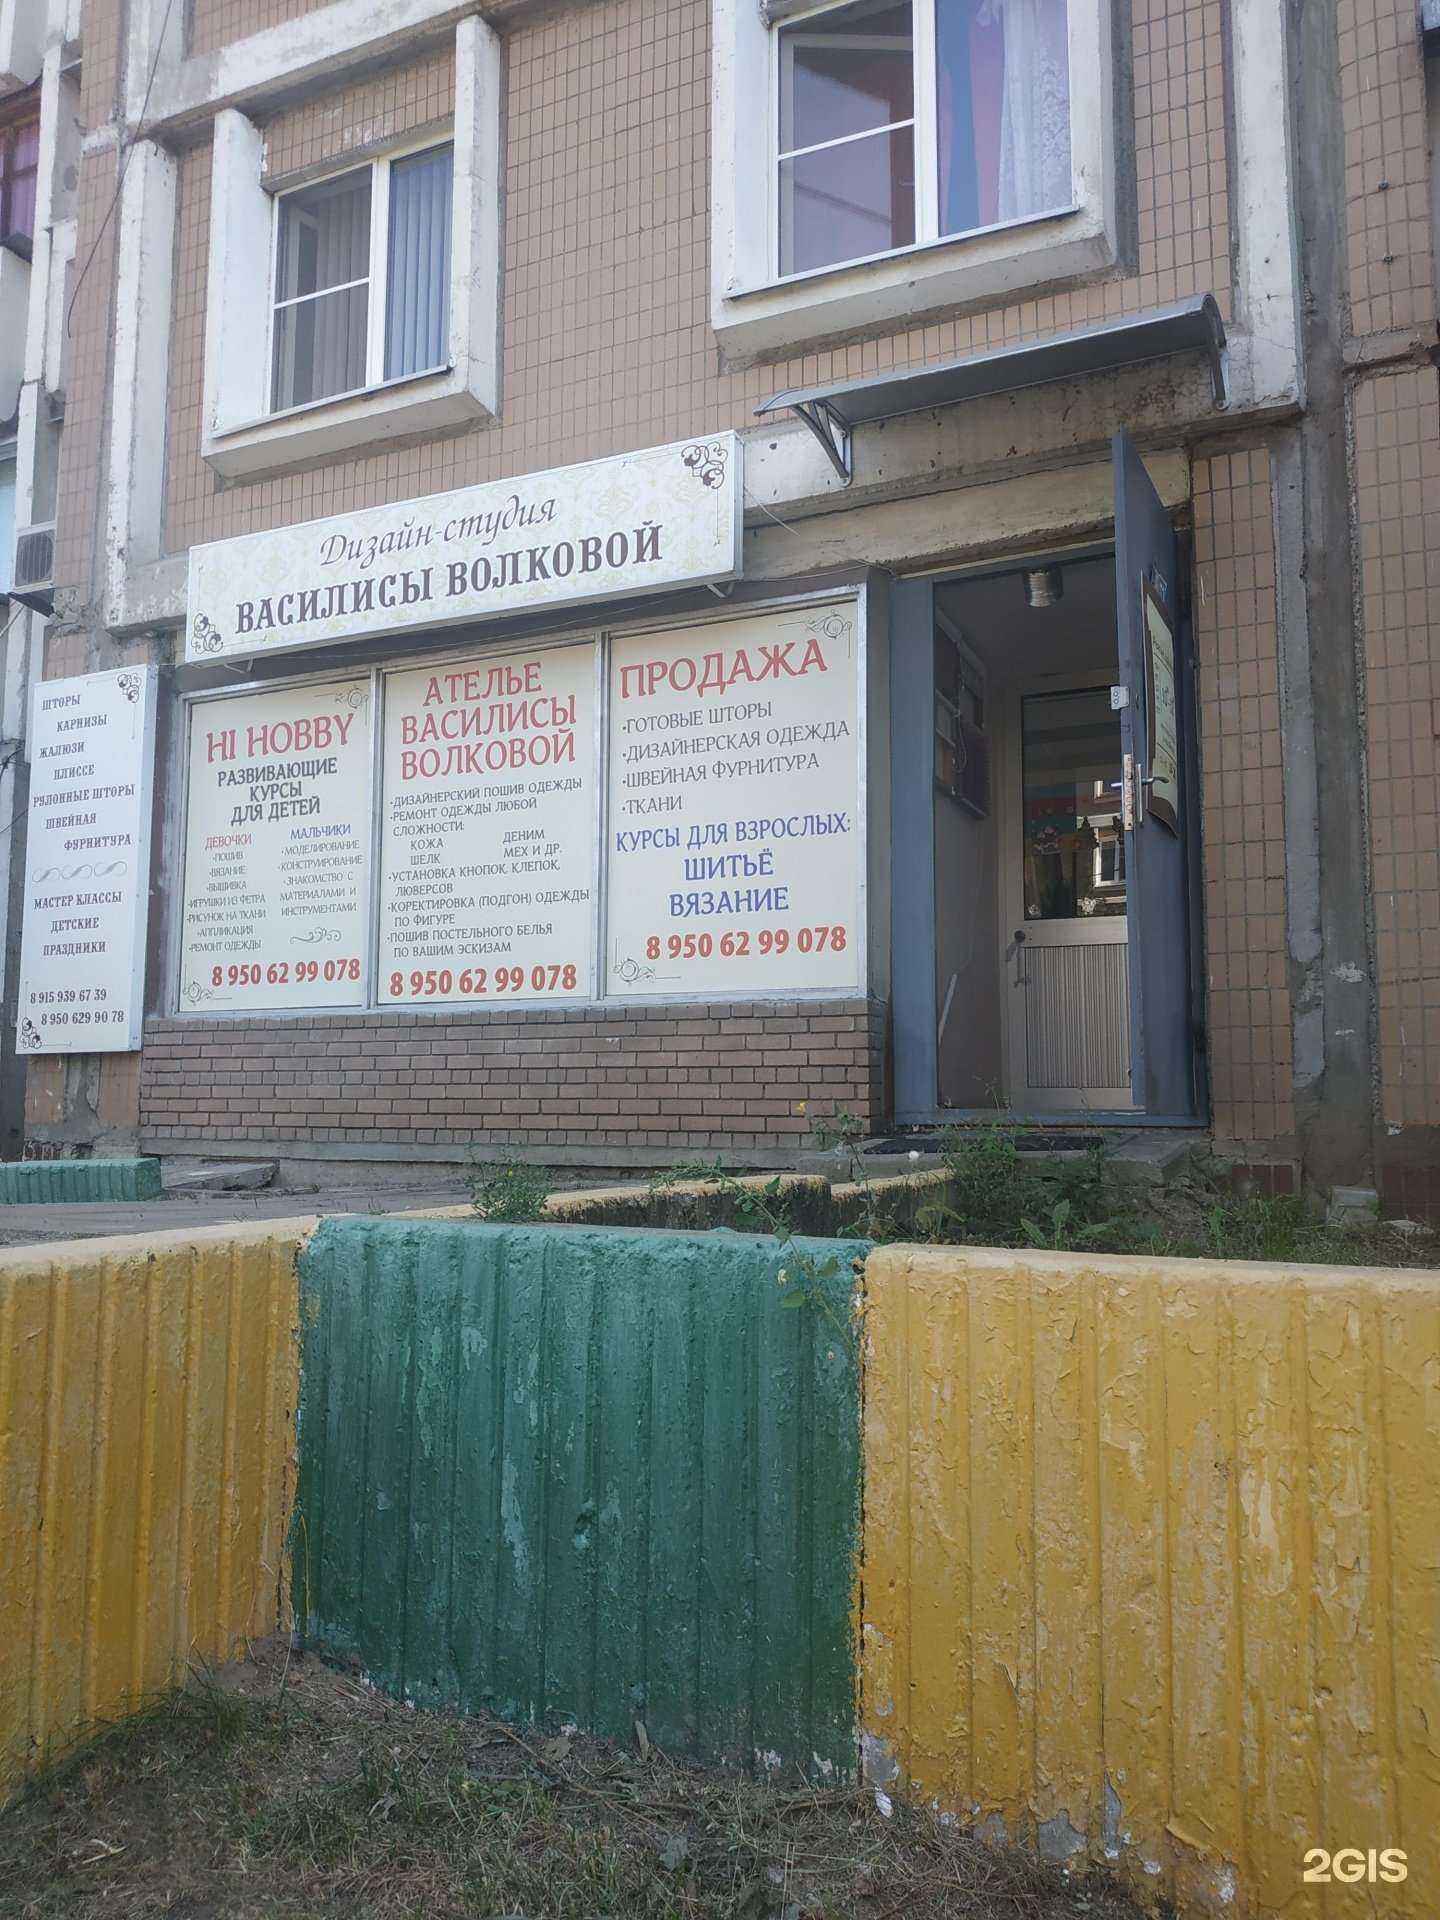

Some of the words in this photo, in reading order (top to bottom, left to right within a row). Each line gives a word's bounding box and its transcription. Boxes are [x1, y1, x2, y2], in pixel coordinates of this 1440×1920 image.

[319, 493, 558, 569] Дизайн-студия
[235, 567, 434, 635] ВАСИЛИСЫ
[445, 520, 663, 598] ВОЛКОВОЙ
[620, 638, 828, 699] ПРОДАЖА
[423, 661, 542, 706] АТЕЛЬЕ
[42, 695, 81, 710] ШТОРЫ
[56, 714, 108, 732] КАРНИЗЫ
[401, 695, 576, 745] ВАСИЛИСЫ
[627, 710, 703, 734] ГОТОВЫЕ
[709, 701, 772, 724] ШТОРЫ
[207, 729, 236, 763] HI
[247, 713, 354, 757] HOBBY
[627, 731, 760, 764] ДИЗАЙНЕРСКАЯ
[766, 720, 850, 746] ОДЕЖДА
[39, 742, 85, 758] ЖАЛЮЗИ
[401, 728, 576, 780] ВОЛКОВОЙ
[53, 764, 95, 780] ПЛИССЕ
[218, 757, 338, 787] РАЗВИВАЮЩИЕ
[627, 765, 706, 787] ШВЕЙНАЯ
[712, 753, 819, 779] ФУРНИТУРА
[33, 790, 90, 808] РУЛОННЫЕ
[92, 784, 135, 799] ШТОРЫ
[250, 781, 302, 802] КУРСЫ
[393, 786, 480, 809] ДИЗАЙНЕРСКИЙ
[484, 783, 524, 799] ПОШИВ
[528, 778, 582, 795] ОДЕЖДЫ
[231, 803, 263, 826] ДЛЯ
[268, 796, 320, 822] ДЕТЕЙ
[393, 808, 437, 822] РЕМОНТ
[441, 802, 492, 818] ОДЕЖДЫ
[495, 797, 537, 813] ЛЮБОЙ
[627, 795, 682, 815] ТКАНИ
[46, 813, 97, 829] ШВЕЙНАЯ
[393, 821, 464, 837] СЛОЖНОСТИ:
[205, 834, 252, 850] ДЕВОЧКИ
[290, 824, 351, 840] МАЛЬЧИКИ
[503, 829, 545, 844] ДЕНИМ
[616, 827, 680, 852] КУРСЫ
[686, 823, 728, 850] ДЛЯ
[735, 812, 851, 843] ВЗРОСЛЫХ:
[64, 834, 131, 851] ФУРНИТУРА
[410, 838, 444, 851] КОЖА
[503, 846, 528, 859] МЕХ
[532, 845, 541, 855] И
[544, 843, 562, 856] ДР.
[410, 853, 441, 866] ШЕЛК
[684, 849, 774, 881] ШИТЬЁ
[392, 866, 456, 882] УСТАНОВКА
[34, 895, 74, 909] МАСТЕР
[76, 891, 122, 905] КЛАССЫ
[395, 883, 453, 897] ЛЮВЕРСОВ
[282, 902, 357, 917] ИНСТРУМЕНТАМИ
[391, 898, 475, 913] КОРЕКТИРОВКА
[478, 893, 532, 908] (ПОДГОН)
[535, 889, 590, 905] ОДЕЖДЫ
[670, 887, 789, 917] ВЯЗАНИЕ
[50, 917, 100, 933] ДЕТСКИЕ
[394, 917, 410, 927] ПО
[413, 914, 455, 926] ФИГУРЕ
[391, 930, 429, 943] ПОШИВ
[432, 925, 513, 941] ПОСТЕЛЬНОГО
[517, 923, 553, 936] БЕЛЬЯ
[646, 936, 660, 960] 8
[668, 933, 712, 959] 950
[720, 931, 749, 957] 62
[759, 930, 789, 955] 99
[797, 926, 846, 953] 078
[42, 941, 106, 956] ПРАЗДНИКИ
[394, 947, 409, 958] ПО
[413, 944, 454, 956] ВАШИМ
[457, 941, 511, 955] ЭСКИЗАМ
[212, 966, 223, 986] 8
[228, 964, 262, 986] 950
[267, 962, 288, 984] 62
[295, 960, 318, 983] 99
[324, 958, 360, 981] 078
[390, 971, 403, 996] 8
[411, 969, 452, 996] 950
[459, 968, 487, 994] 62
[495, 966, 524, 993] 99
[531, 964, 577, 991] 078
[30, 992, 36, 1004] 8
[38, 992, 54, 1003] 915
[57, 990, 76, 1002] 939
[79, 989, 91, 1001] 67
[94, 989, 107, 1001] 39
[41, 1013, 47, 1025] 8
[50, 1013, 68, 1024] 950
[72, 1012, 91, 1023] 629
[95, 1012, 108, 1023] 90
[112, 1011, 124, 1022] 78
